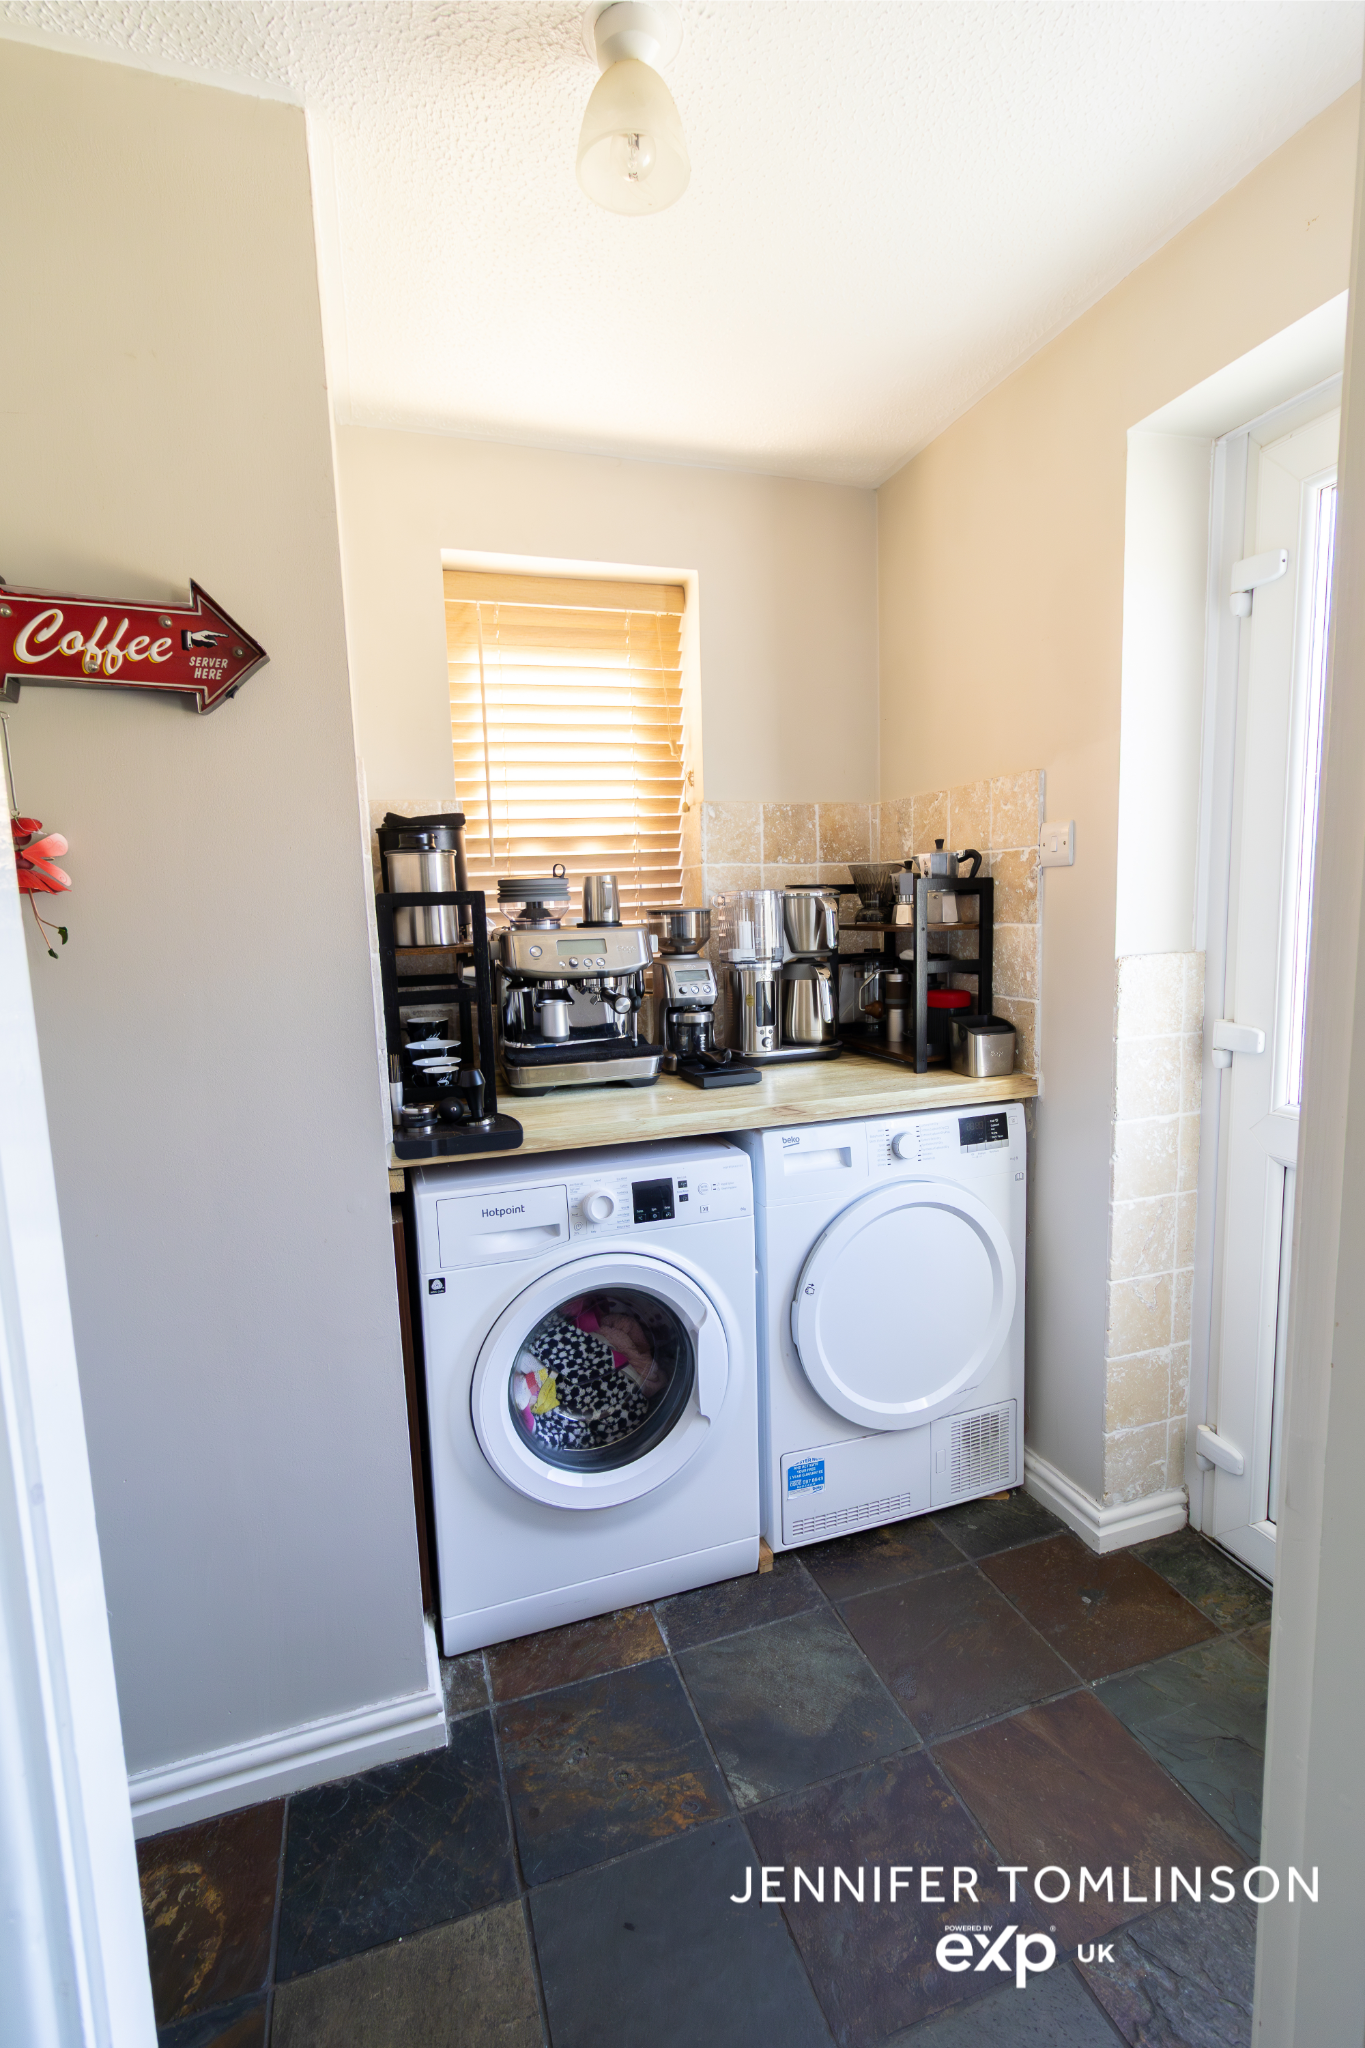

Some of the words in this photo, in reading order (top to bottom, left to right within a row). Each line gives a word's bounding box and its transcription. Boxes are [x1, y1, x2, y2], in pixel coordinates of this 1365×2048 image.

[13, 608, 173, 675] Coffee
[189, 656, 228, 669] SERVER
[194, 667, 223, 680] HERE
[782, 1136, 800, 1145] beko
[481, 1204, 526, 1218] Hotpoint
